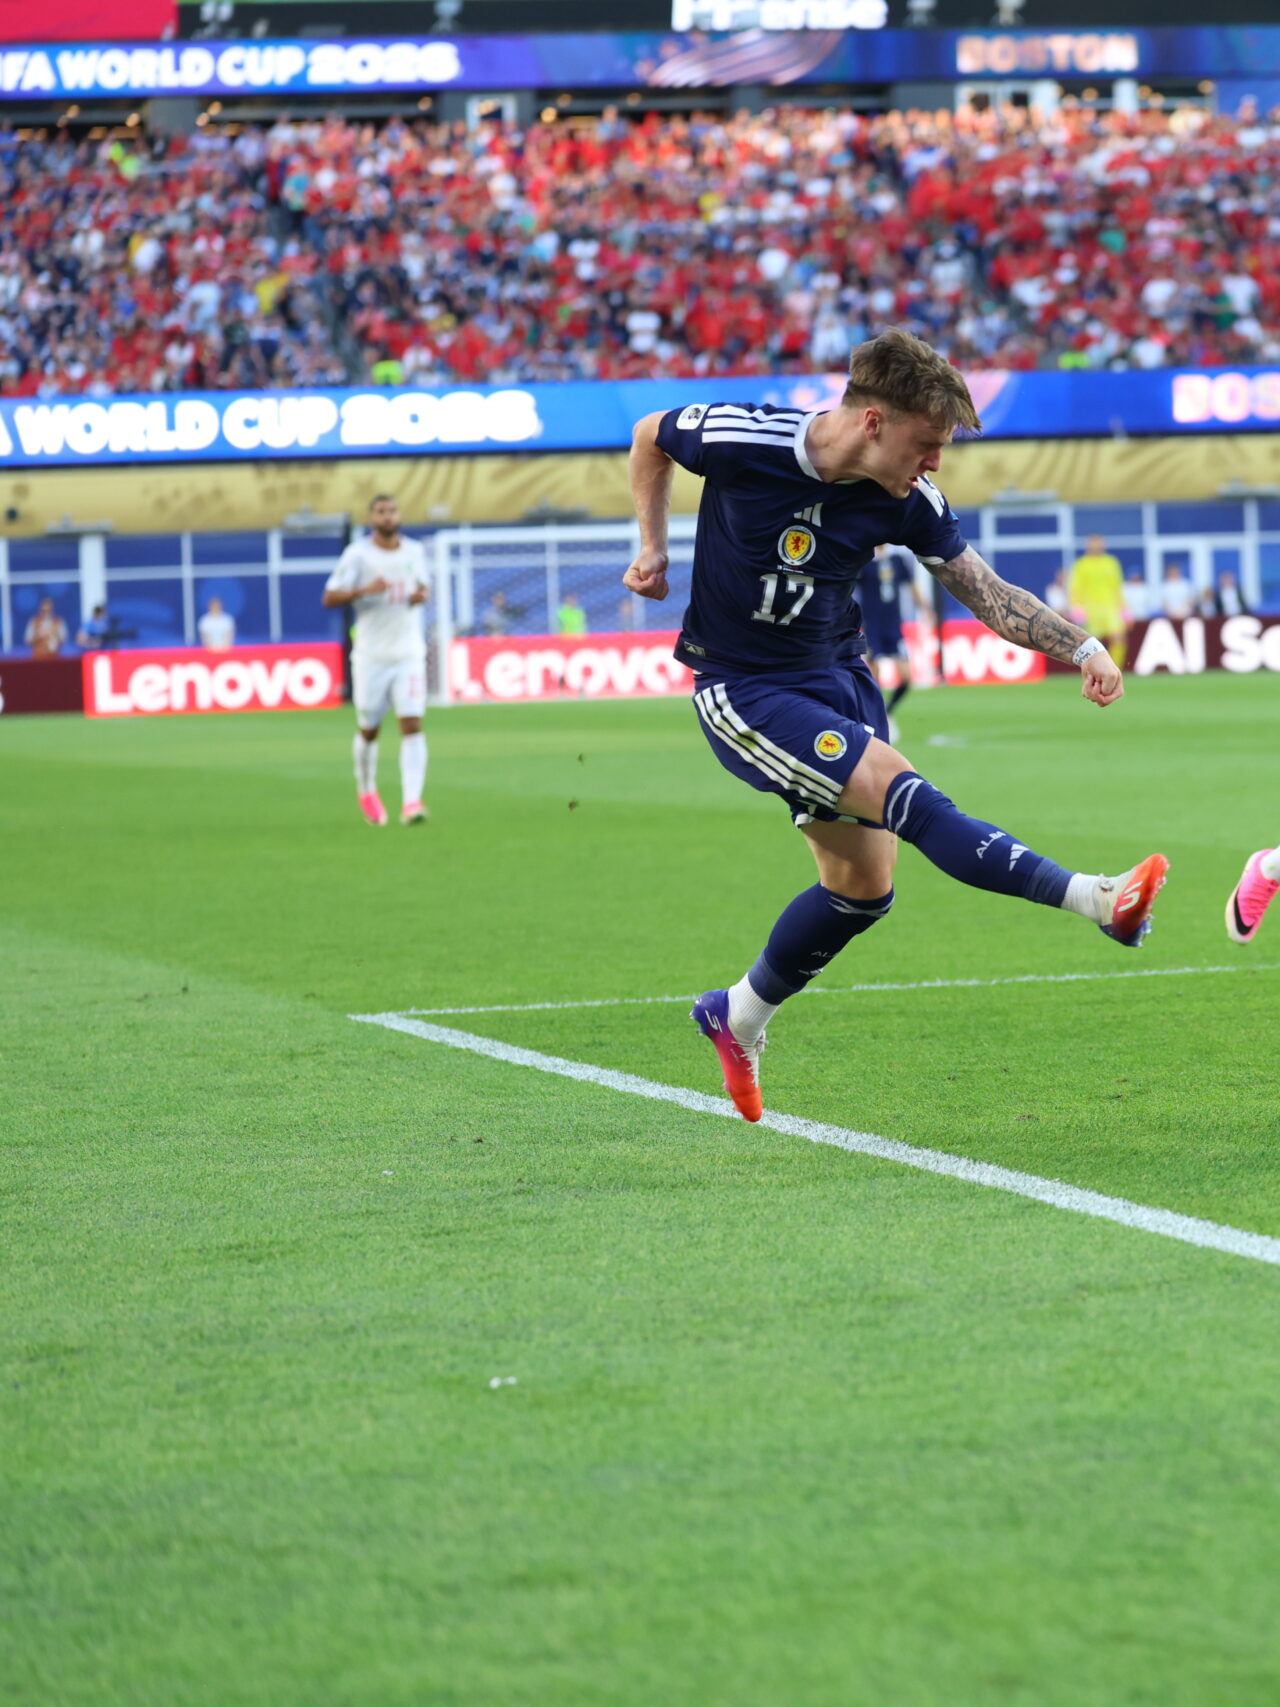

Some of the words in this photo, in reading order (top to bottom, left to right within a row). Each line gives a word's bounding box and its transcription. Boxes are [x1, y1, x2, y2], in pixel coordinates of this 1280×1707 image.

[0, 51, 56, 91] FA
[56, 45, 215, 90] WORLD
[216, 45, 304, 87] CUP
[306, 42, 460, 84] 2026
[956, 35, 1139, 73] BOSTON
[14, 400, 220, 455] WORLD
[221, 397, 338, 449] CUP
[340, 390, 541, 445] 2026
[752, 573, 814, 626] 17
[450, 643, 685, 699] Lenovo
[1134, 617, 1206, 676] AI
[93, 656, 331, 713] Lenovo
[976, 831, 1006, 859] ALBA
